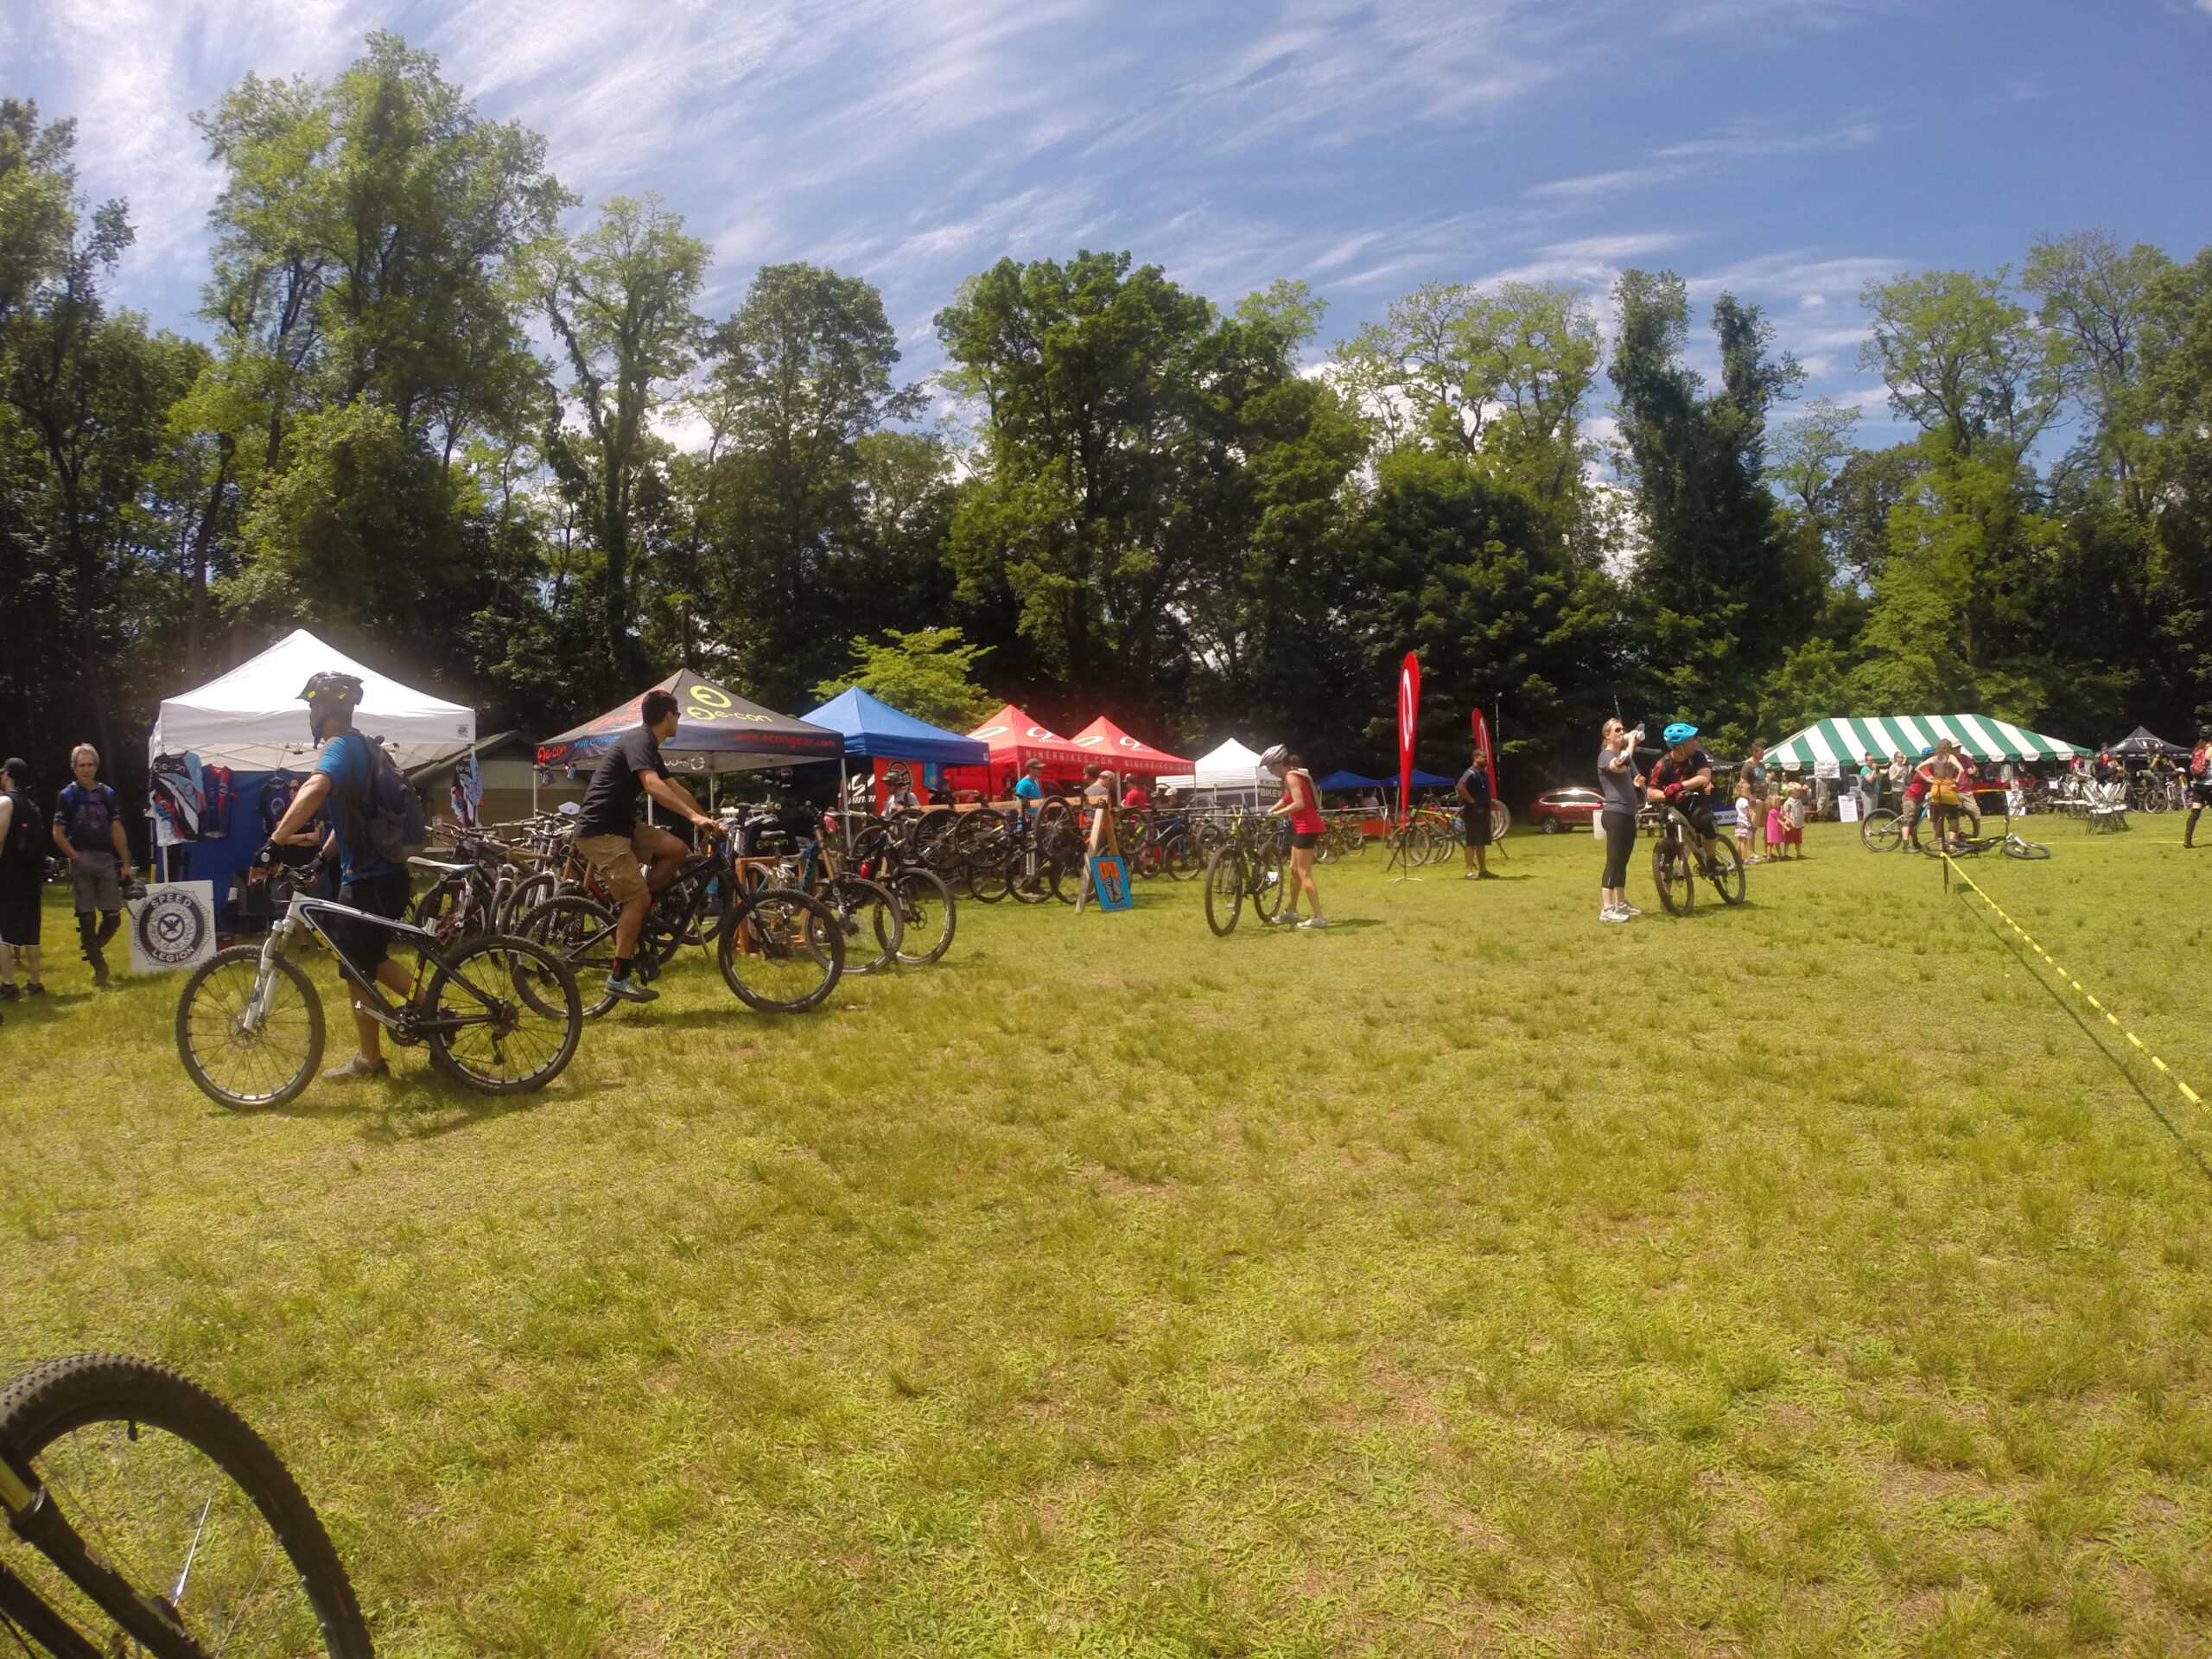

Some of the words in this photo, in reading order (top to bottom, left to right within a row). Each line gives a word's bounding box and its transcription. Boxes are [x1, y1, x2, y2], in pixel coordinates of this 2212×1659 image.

[1025, 750, 1114, 765] NINERBIKES.COM
[150, 893, 192, 908] SPEED
[152, 946, 195, 962] LEGION
